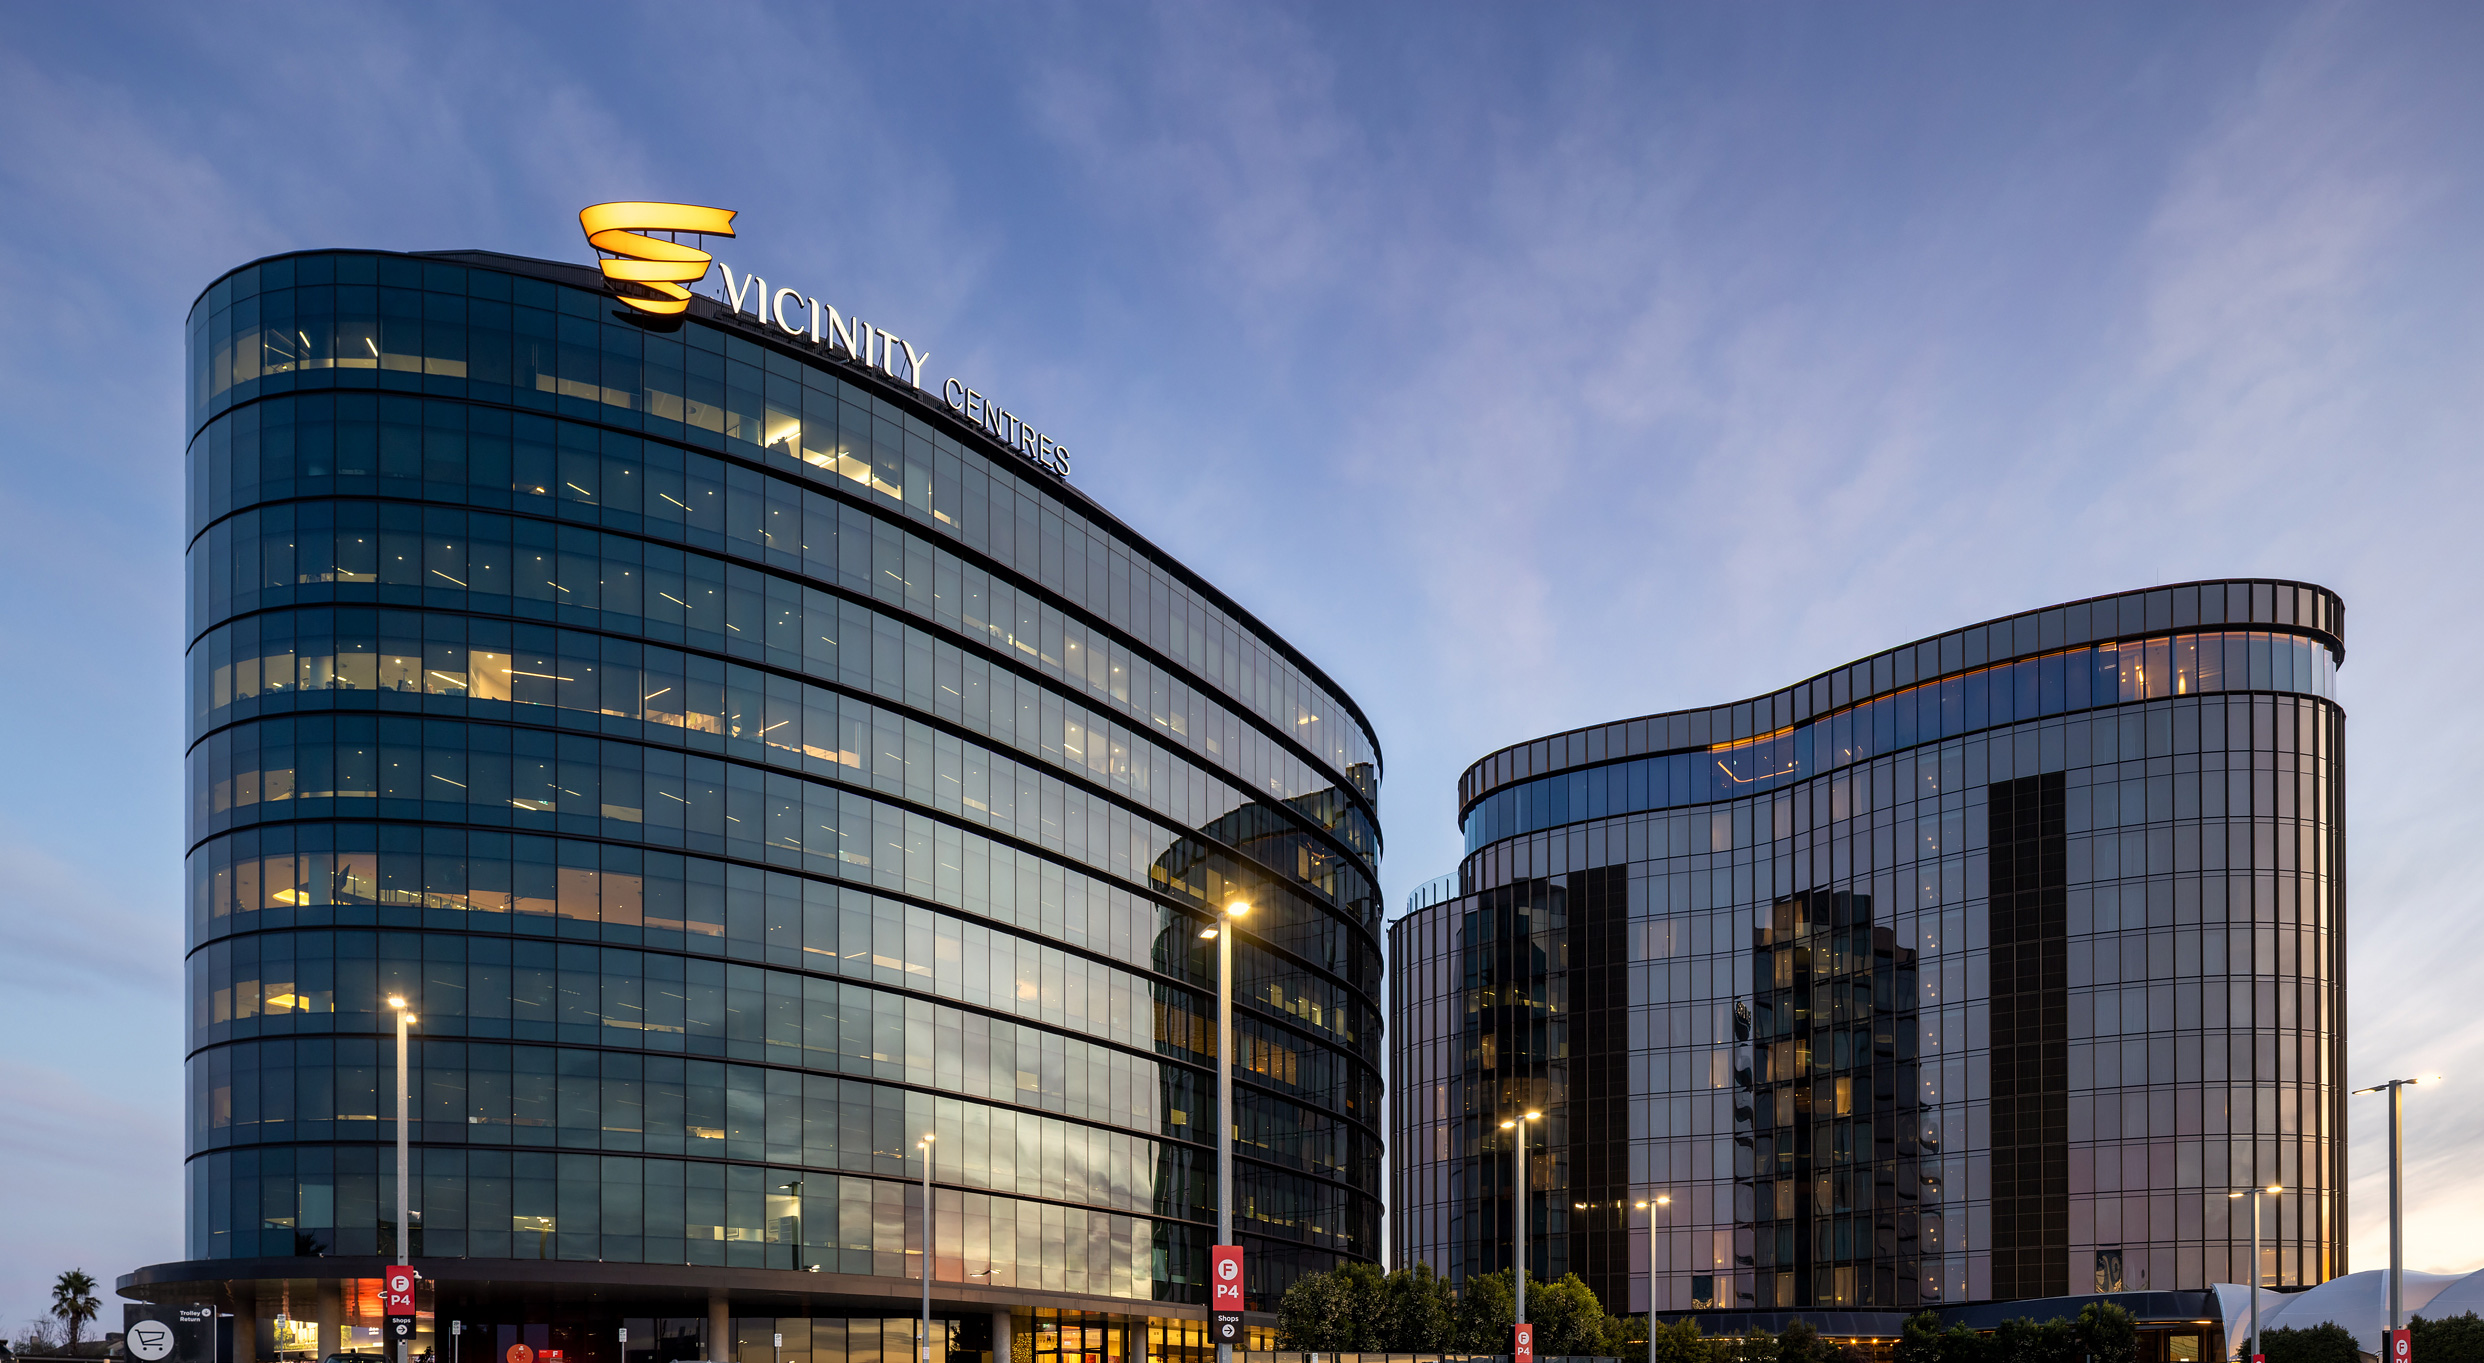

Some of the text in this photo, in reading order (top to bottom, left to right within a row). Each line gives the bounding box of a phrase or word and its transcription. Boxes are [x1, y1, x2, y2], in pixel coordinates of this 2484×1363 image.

[719, 262, 1071, 477] VICINITY CENTRES
[1223, 1263, 1232, 1276] F
[396, 1279, 404, 1288] F
[1217, 1284, 1239, 1298] P4
[391, 1294, 410, 1306] P4
[1520, 1334, 1526, 1342] F
[1517, 1346, 1530, 1356] P4
[2399, 1342, 2405, 1352] F
